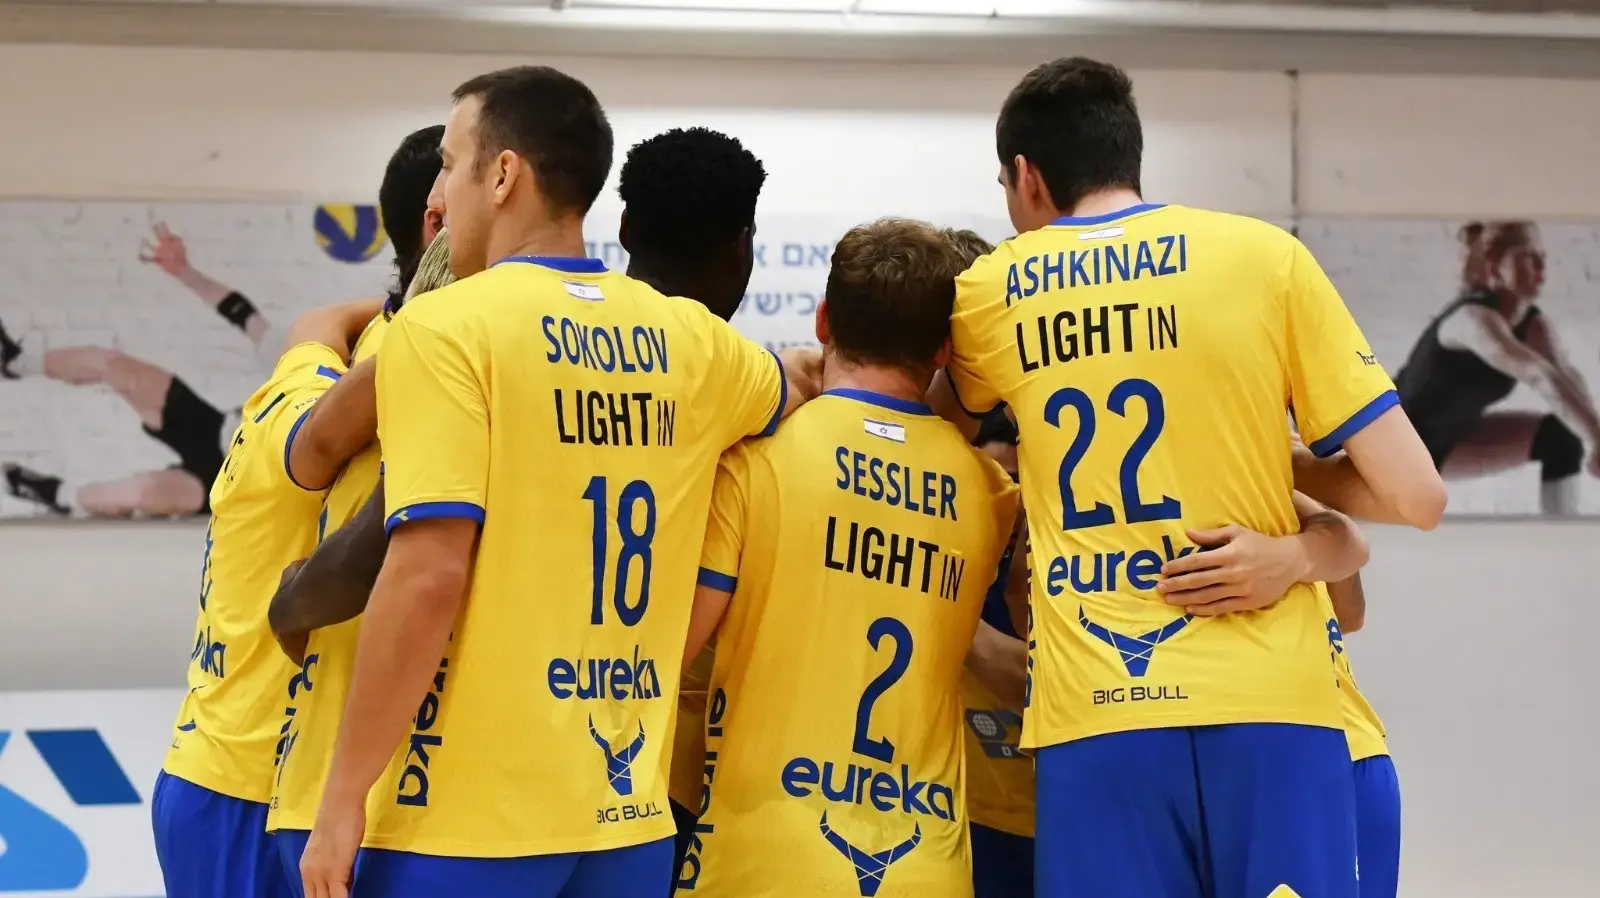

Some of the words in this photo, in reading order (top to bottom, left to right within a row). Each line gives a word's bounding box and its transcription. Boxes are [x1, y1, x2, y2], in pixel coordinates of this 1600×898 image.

[1005, 233, 1187, 308] ASHKINAZI
[541, 315, 668, 374] SOKOLOV
[1016, 302, 1139, 374] LIGHT
[554, 388, 652, 446] LIGHT
[835, 446, 957, 521] SESSLER
[1043, 378, 1182, 531] 22
[581, 475, 656, 627] 18
[825, 516, 939, 593] LIGHT
[1047, 535, 1204, 596] eurek
[547, 644, 661, 700] eureka
[852, 616, 913, 764] 2
[1093, 688, 1125, 705] BIG
[1131, 686, 1188, 701] BULL
[597, 808, 619, 824] BIG
[622, 802, 662, 820] BULL
[781, 756, 957, 822] eureka
